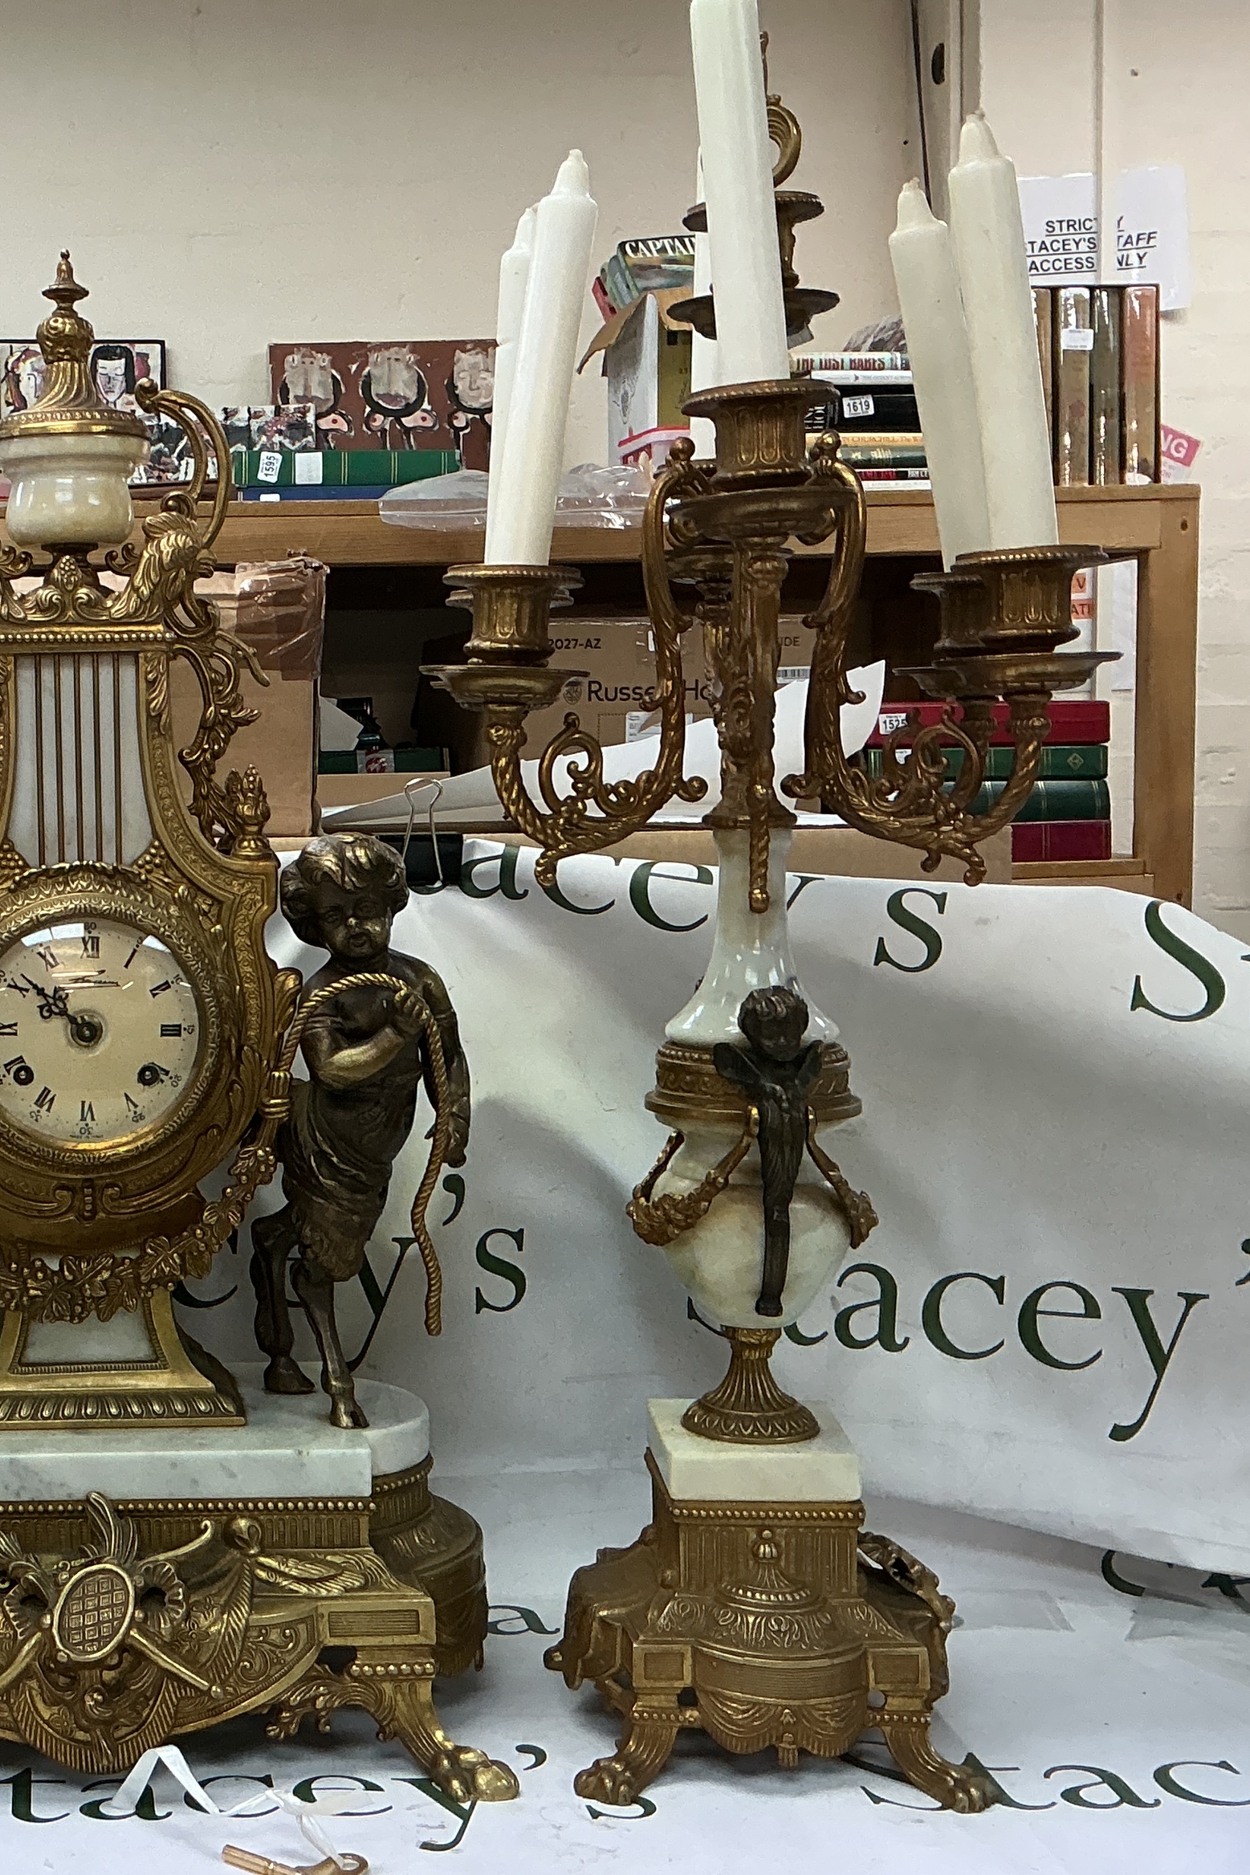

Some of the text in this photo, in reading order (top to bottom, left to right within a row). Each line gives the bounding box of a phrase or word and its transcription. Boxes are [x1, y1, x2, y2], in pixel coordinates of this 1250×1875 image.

[1044, 214, 1125, 235] STRICY
[1023, 230, 1158, 255] TACEY'S TAFF
[1028, 251, 1148, 273] ACCESS NLY
[846, 400, 870, 413] 1619
[264, 455, 276, 477] 1595
[587, 680, 657, 702] Russe
[80, 936, 100, 959] XII
[6, 977, 31, 998] X
[159, 1023, 182, 1037] III
[79, 1100, 96, 1121] VI
